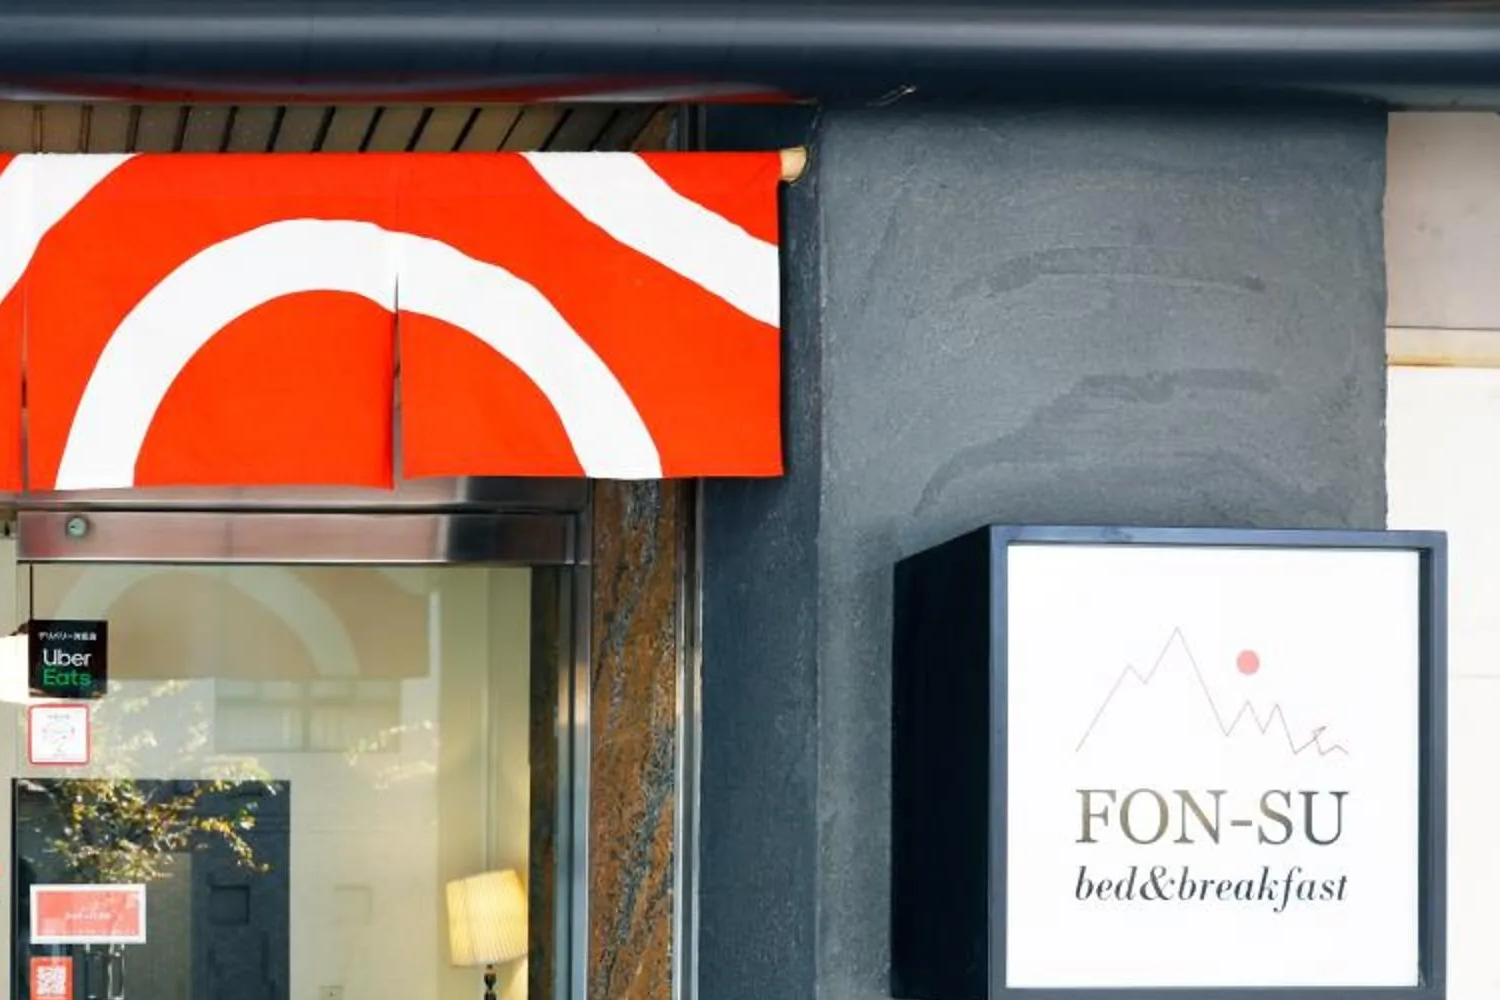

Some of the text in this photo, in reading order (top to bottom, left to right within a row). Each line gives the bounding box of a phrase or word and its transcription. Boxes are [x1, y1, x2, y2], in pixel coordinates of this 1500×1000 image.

[43, 648, 92, 667] Uber
[43, 668, 92, 686] Eats
[1075, 787, 1349, 845] FON-SU
[1075, 865, 1349, 913] bed&breakfast
